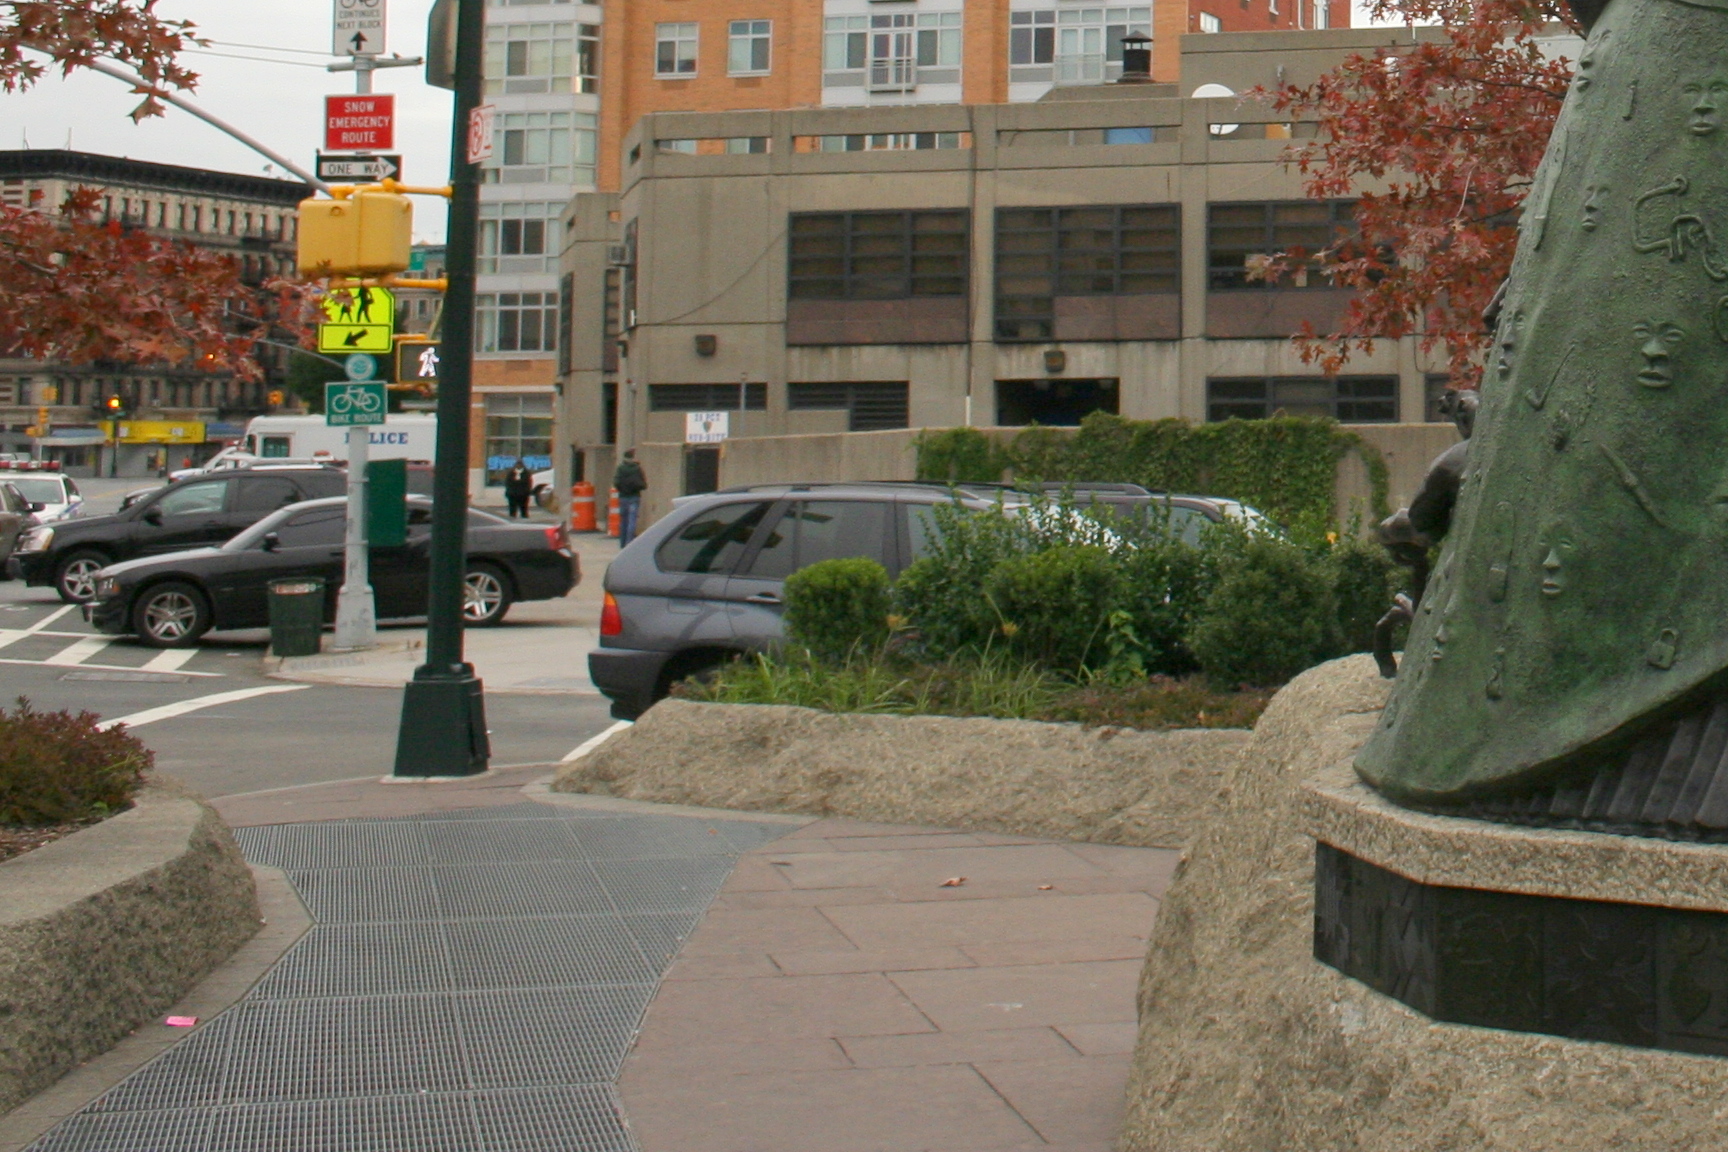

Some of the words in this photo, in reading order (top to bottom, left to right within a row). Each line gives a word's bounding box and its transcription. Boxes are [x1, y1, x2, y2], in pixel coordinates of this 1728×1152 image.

[337, 21, 355, 30] NEXT
[358, 20, 381, 29] BLOCK
[344, 101, 376, 113] SNOW
[328, 115, 391, 128] EMERGENCY
[341, 131, 377, 144] ROUTE
[328, 163, 351, 175] ONE
[364, 163, 389, 174] WAY
[330, 414, 351, 423] BIKE
[353, 413, 382, 423] ROUTE
[343, 432, 409, 445] PLICE
